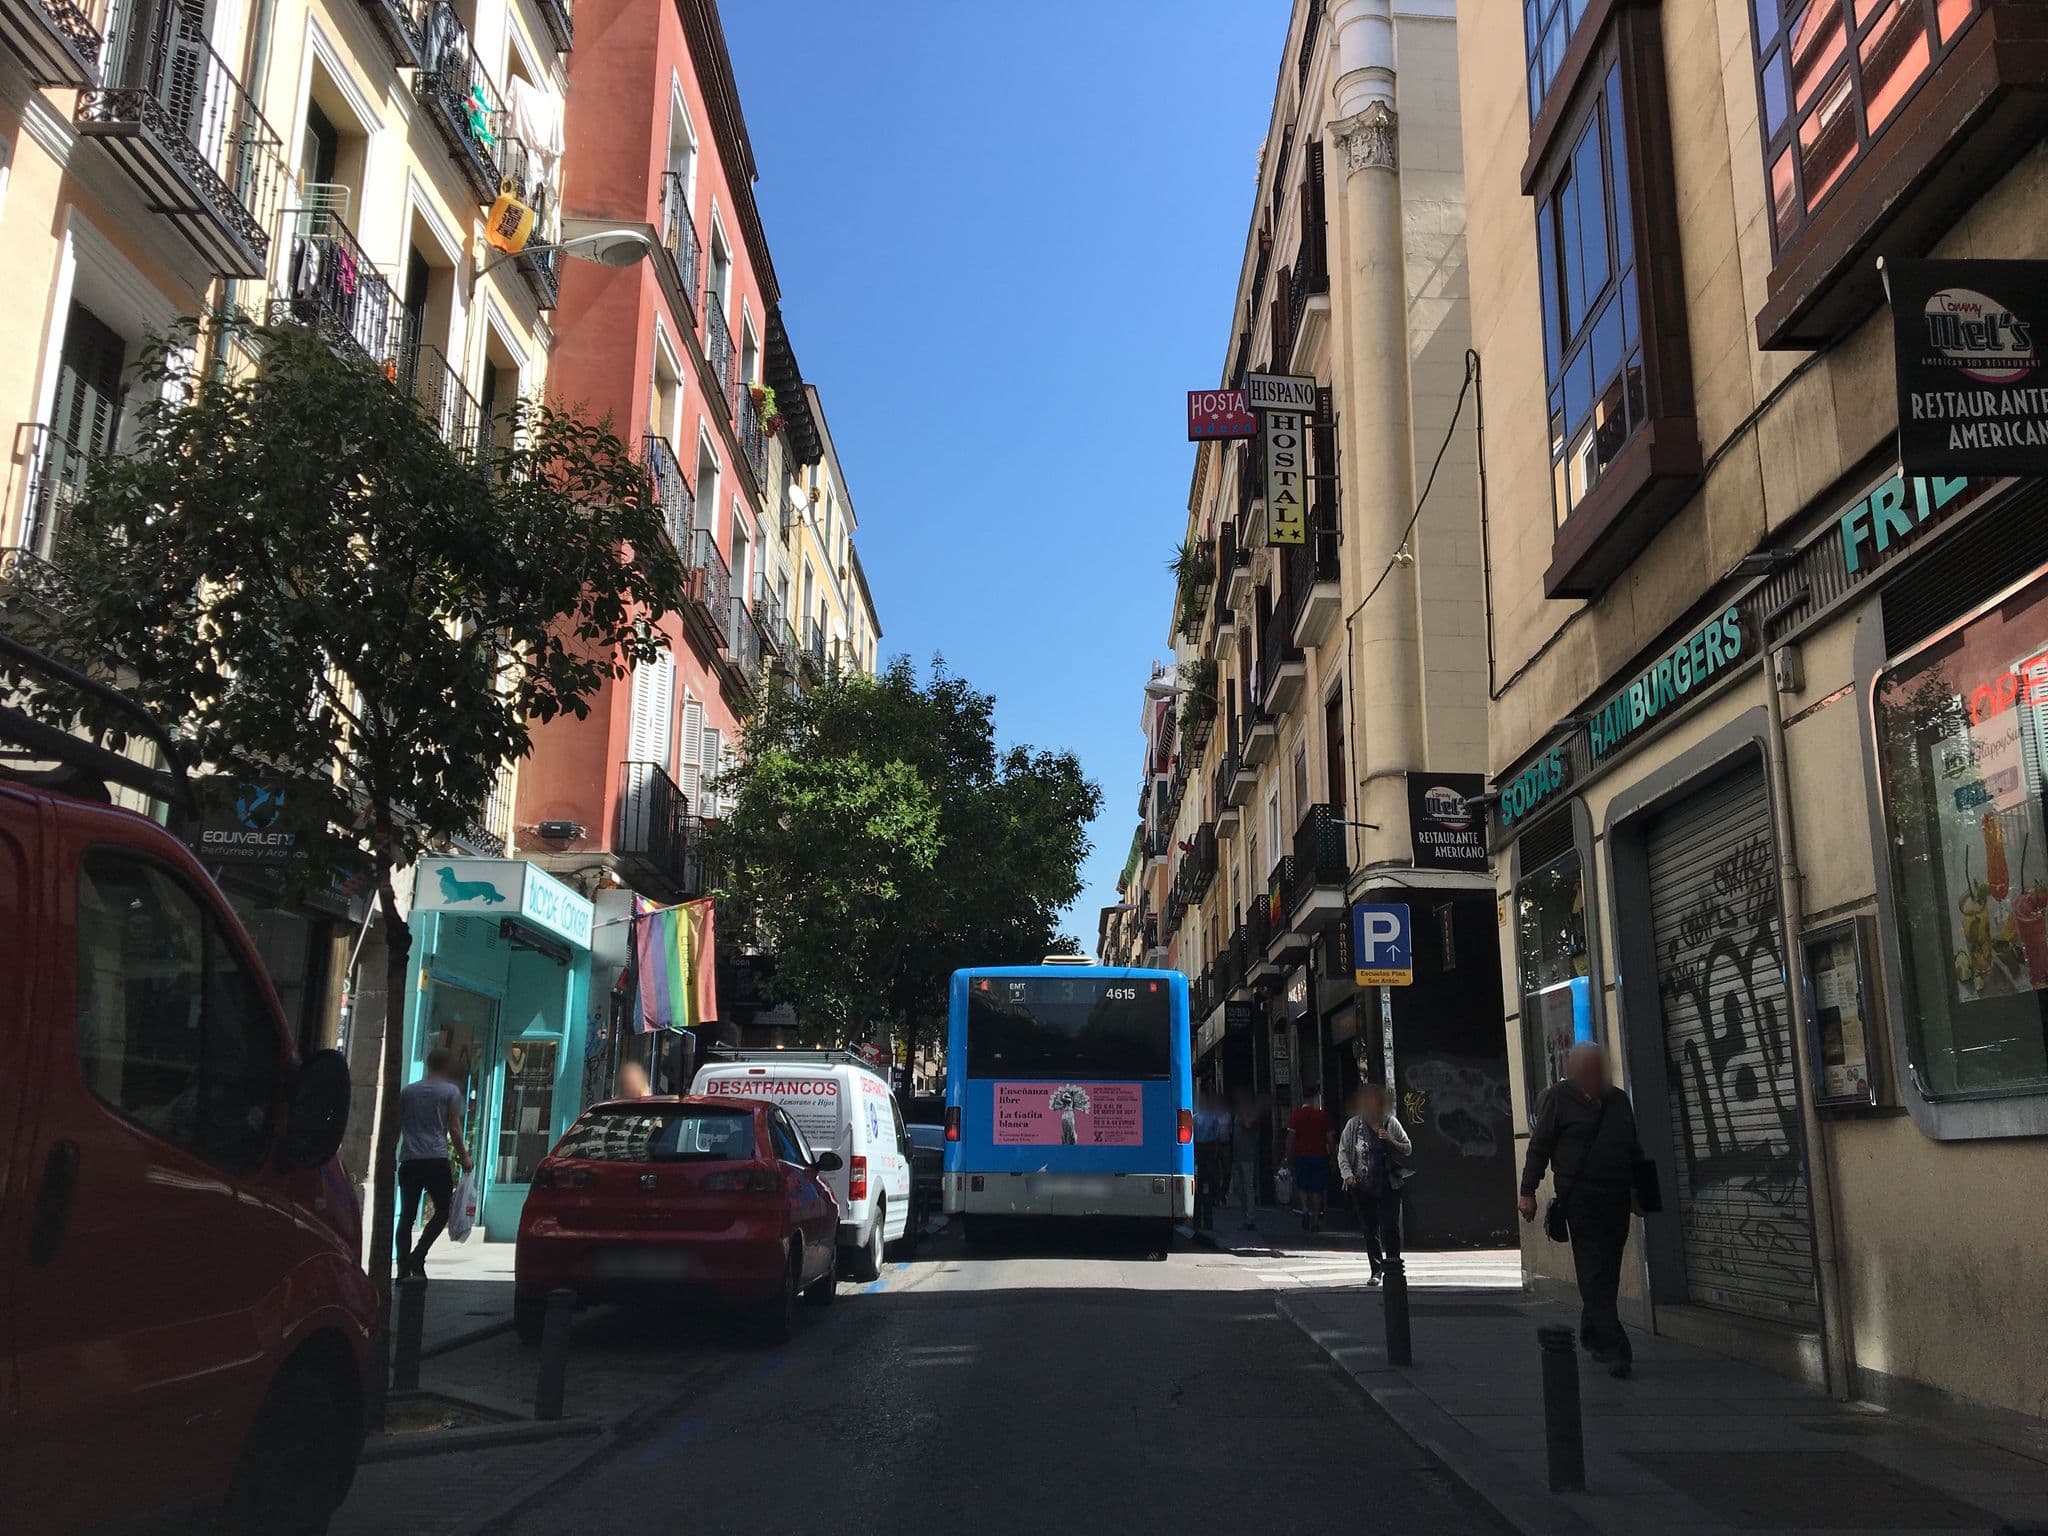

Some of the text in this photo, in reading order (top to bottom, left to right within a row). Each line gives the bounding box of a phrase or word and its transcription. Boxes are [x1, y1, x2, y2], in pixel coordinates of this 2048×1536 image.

[1931, 293, 1983, 318] Tommy
[1924, 312, 2034, 352] Mel's
[1251, 379, 1314, 405] HISPANO
[1911, 387, 2048, 420] RESTAURANTE
[1192, 393, 1254, 419] HOSTA
[1271, 414, 1299, 524] HOSTAL
[1588, 606, 1742, 761] HAMBURGERS
[1501, 745, 1564, 826] SODAS
[1418, 831, 1479, 845] RESTAURANTE
[1435, 846, 1485, 858] AMERICANO
[1363, 912, 1401, 962] P
[1106, 988, 1135, 1000] 4615
[707, 1081, 838, 1096] DESATRANCOS
[999, 1096, 1020, 1104] libre
[999, 1120, 1028, 1128] blanca
